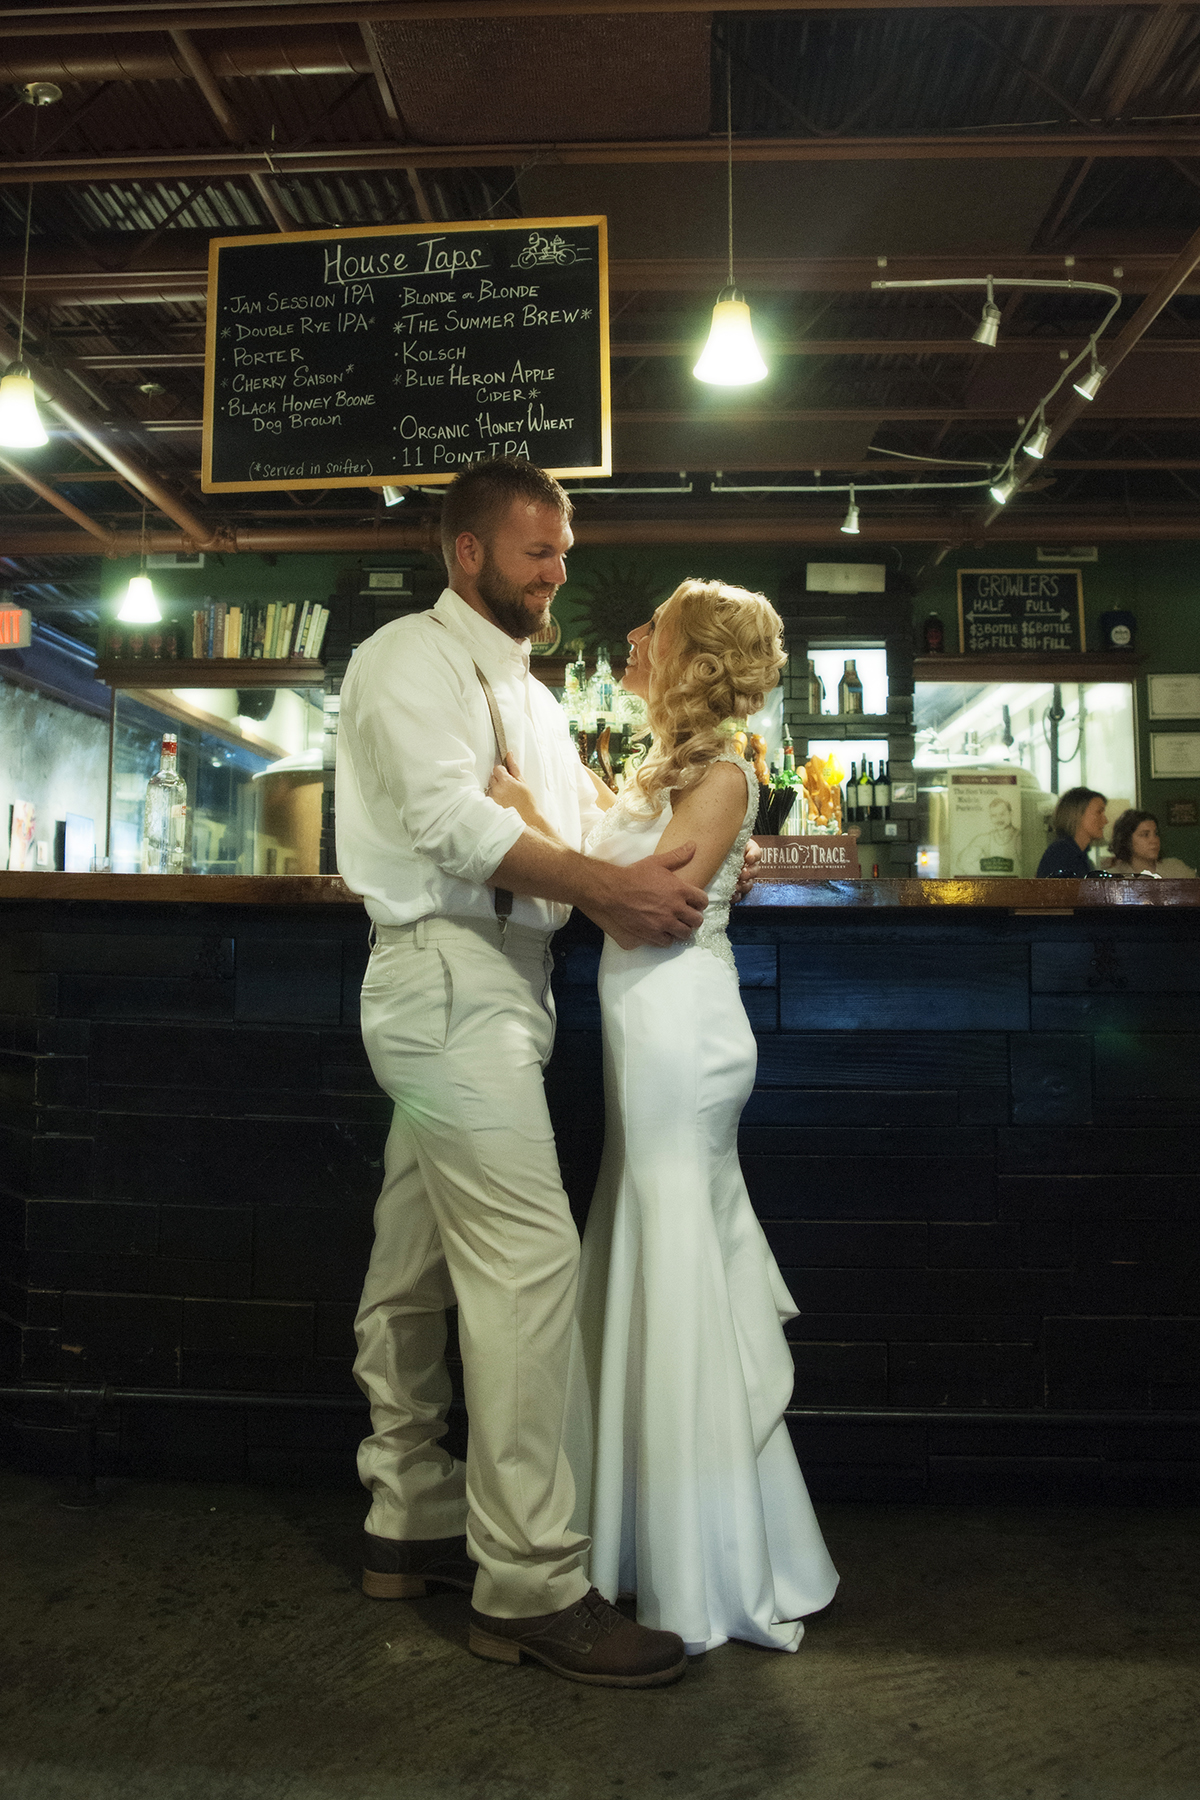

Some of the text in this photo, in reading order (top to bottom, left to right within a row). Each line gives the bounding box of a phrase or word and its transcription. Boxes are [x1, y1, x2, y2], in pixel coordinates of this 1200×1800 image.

[324, 237, 482, 285] House Taps
[344, 283, 374, 305] IPA
[253, 414, 342, 435] Dog Brown
[310, 462, 321, 475] in
[978, 575, 1060, 597] GROWLERS
[973, 599, 1004, 612] HALF
[1025, 600, 1055, 613] FULL
[760, 844, 846, 865] UFFALO TRACE
